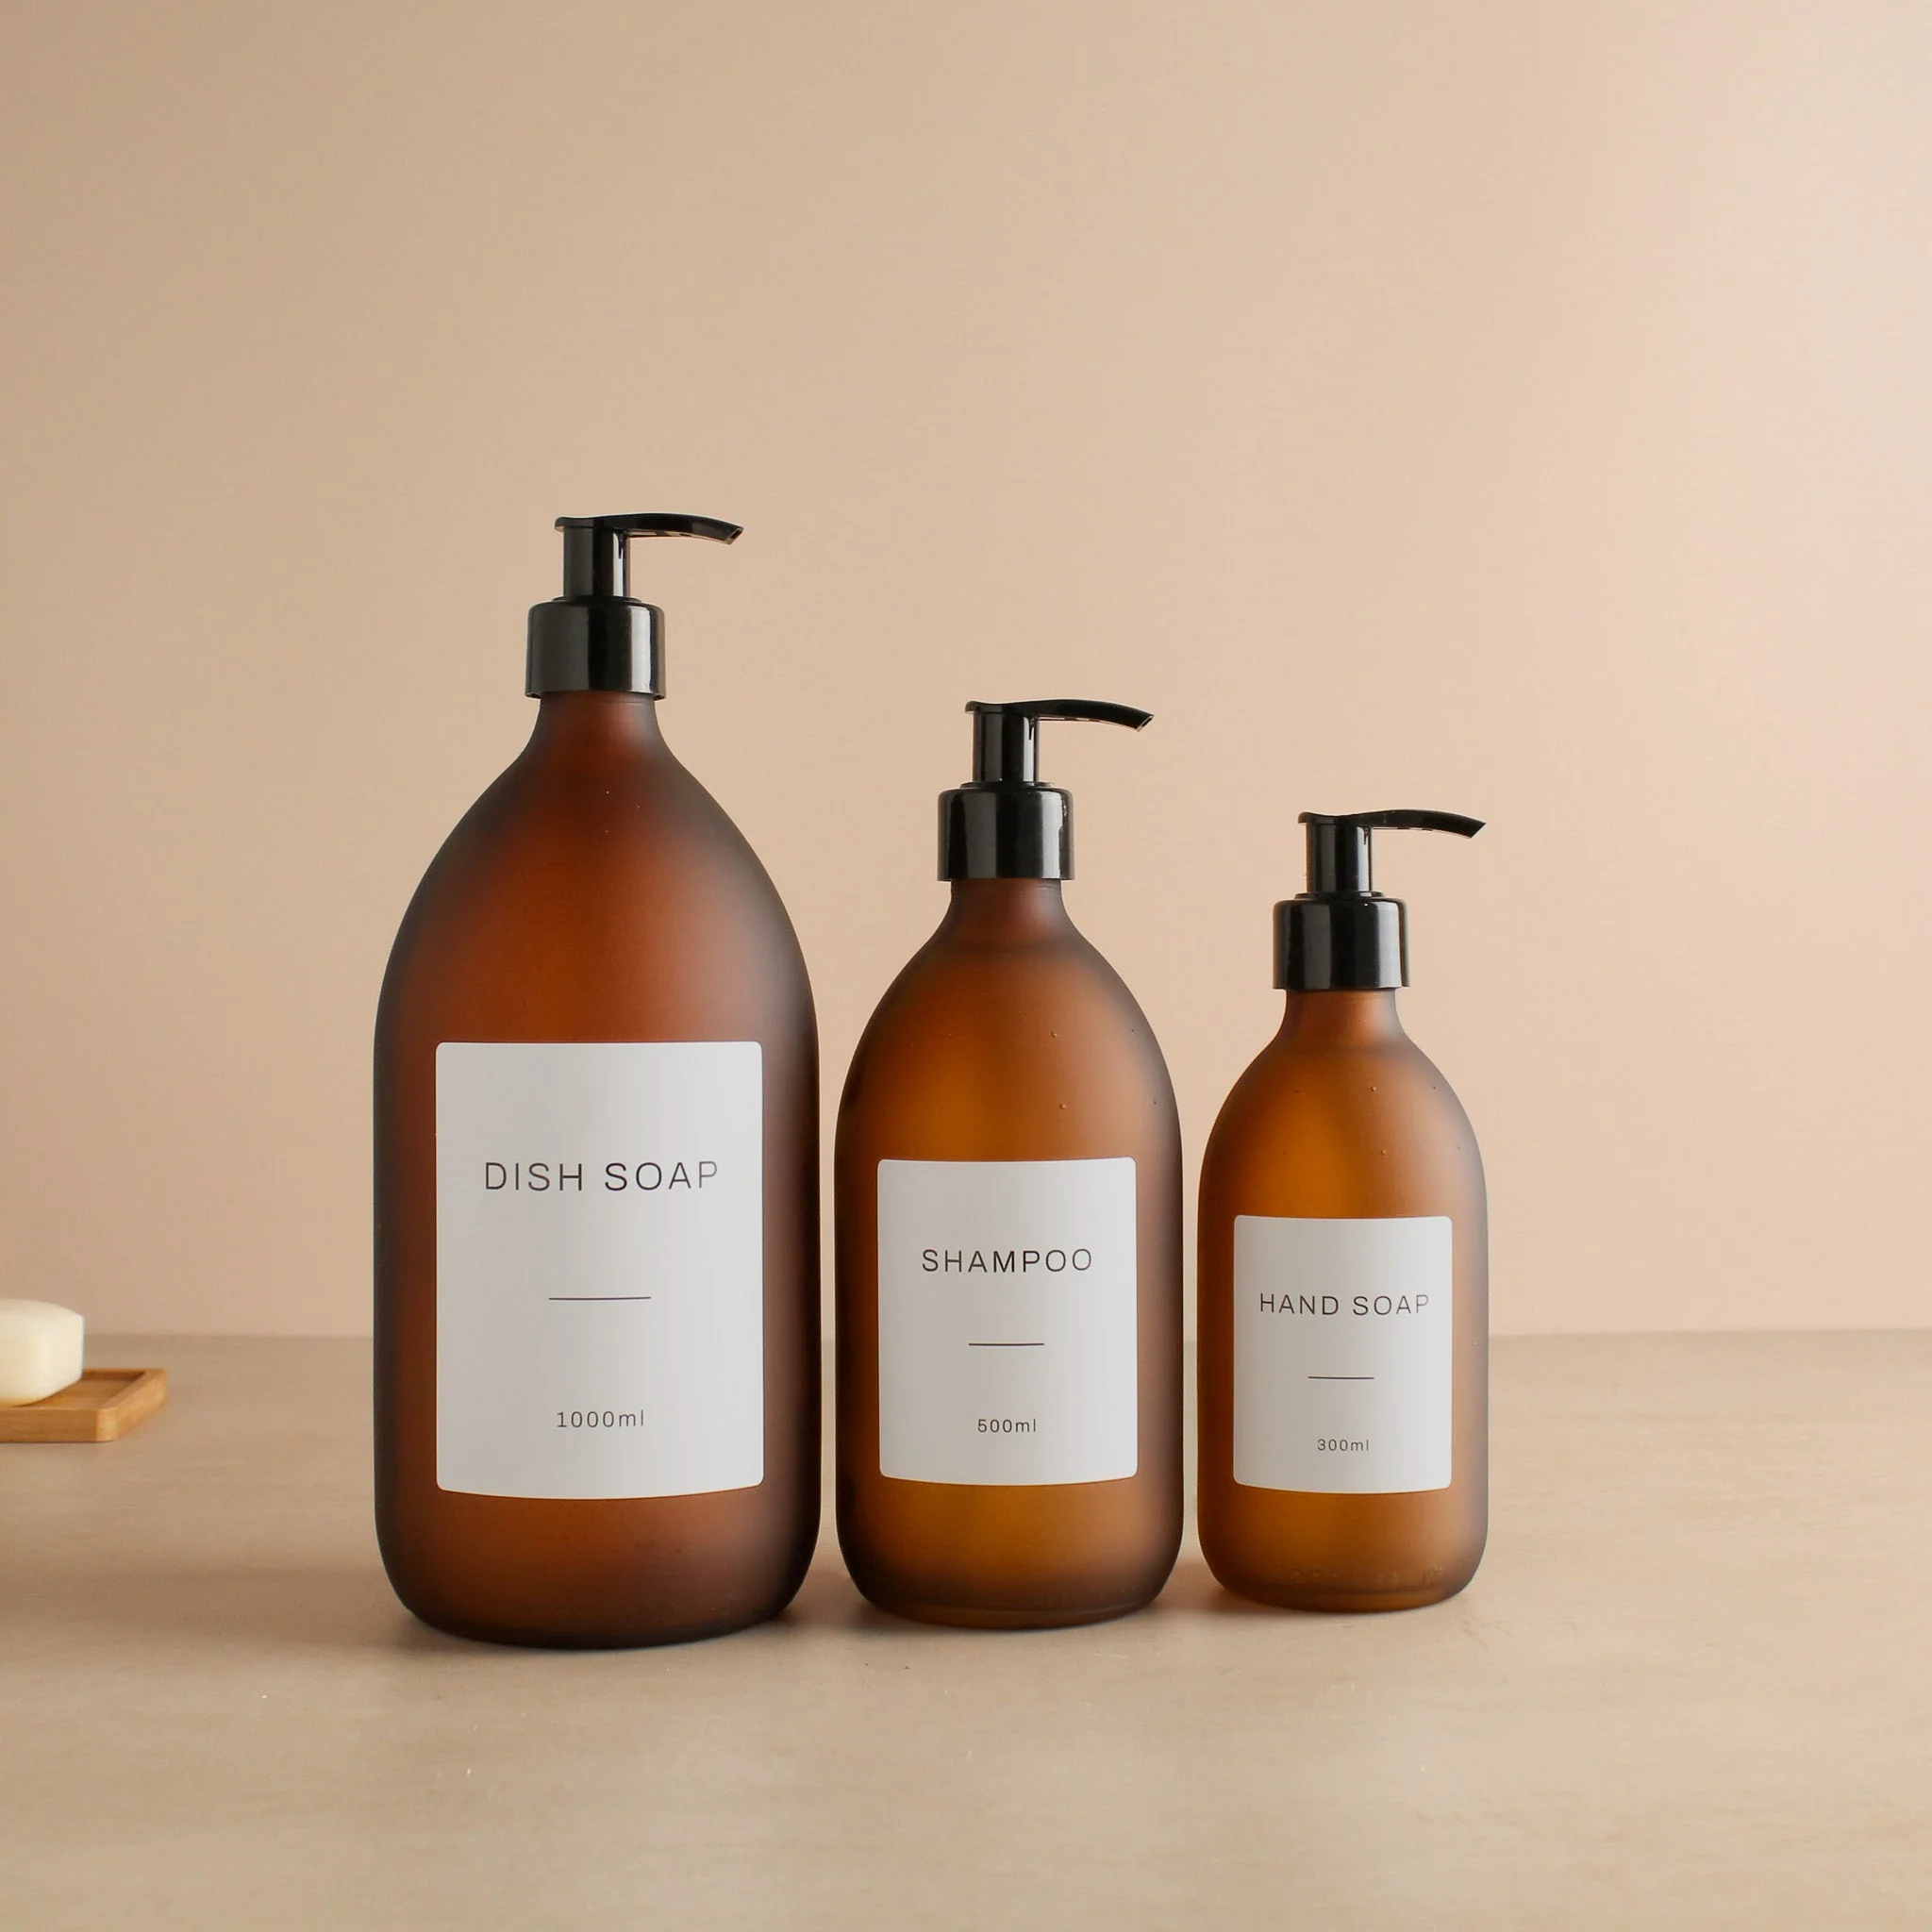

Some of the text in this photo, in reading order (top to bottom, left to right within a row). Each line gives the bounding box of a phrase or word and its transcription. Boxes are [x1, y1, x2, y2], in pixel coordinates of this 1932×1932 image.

[485, 1161, 718, 1192] DISH SOAP
[922, 1247, 1092, 1274] SHAMPOO
[1259, 1291, 1429, 1317] HAND SOAP
[557, 1409, 644, 1429] 1000ml
[976, 1418, 1037, 1434] 500ml
[1317, 1438, 1370, 1453] 300ml
